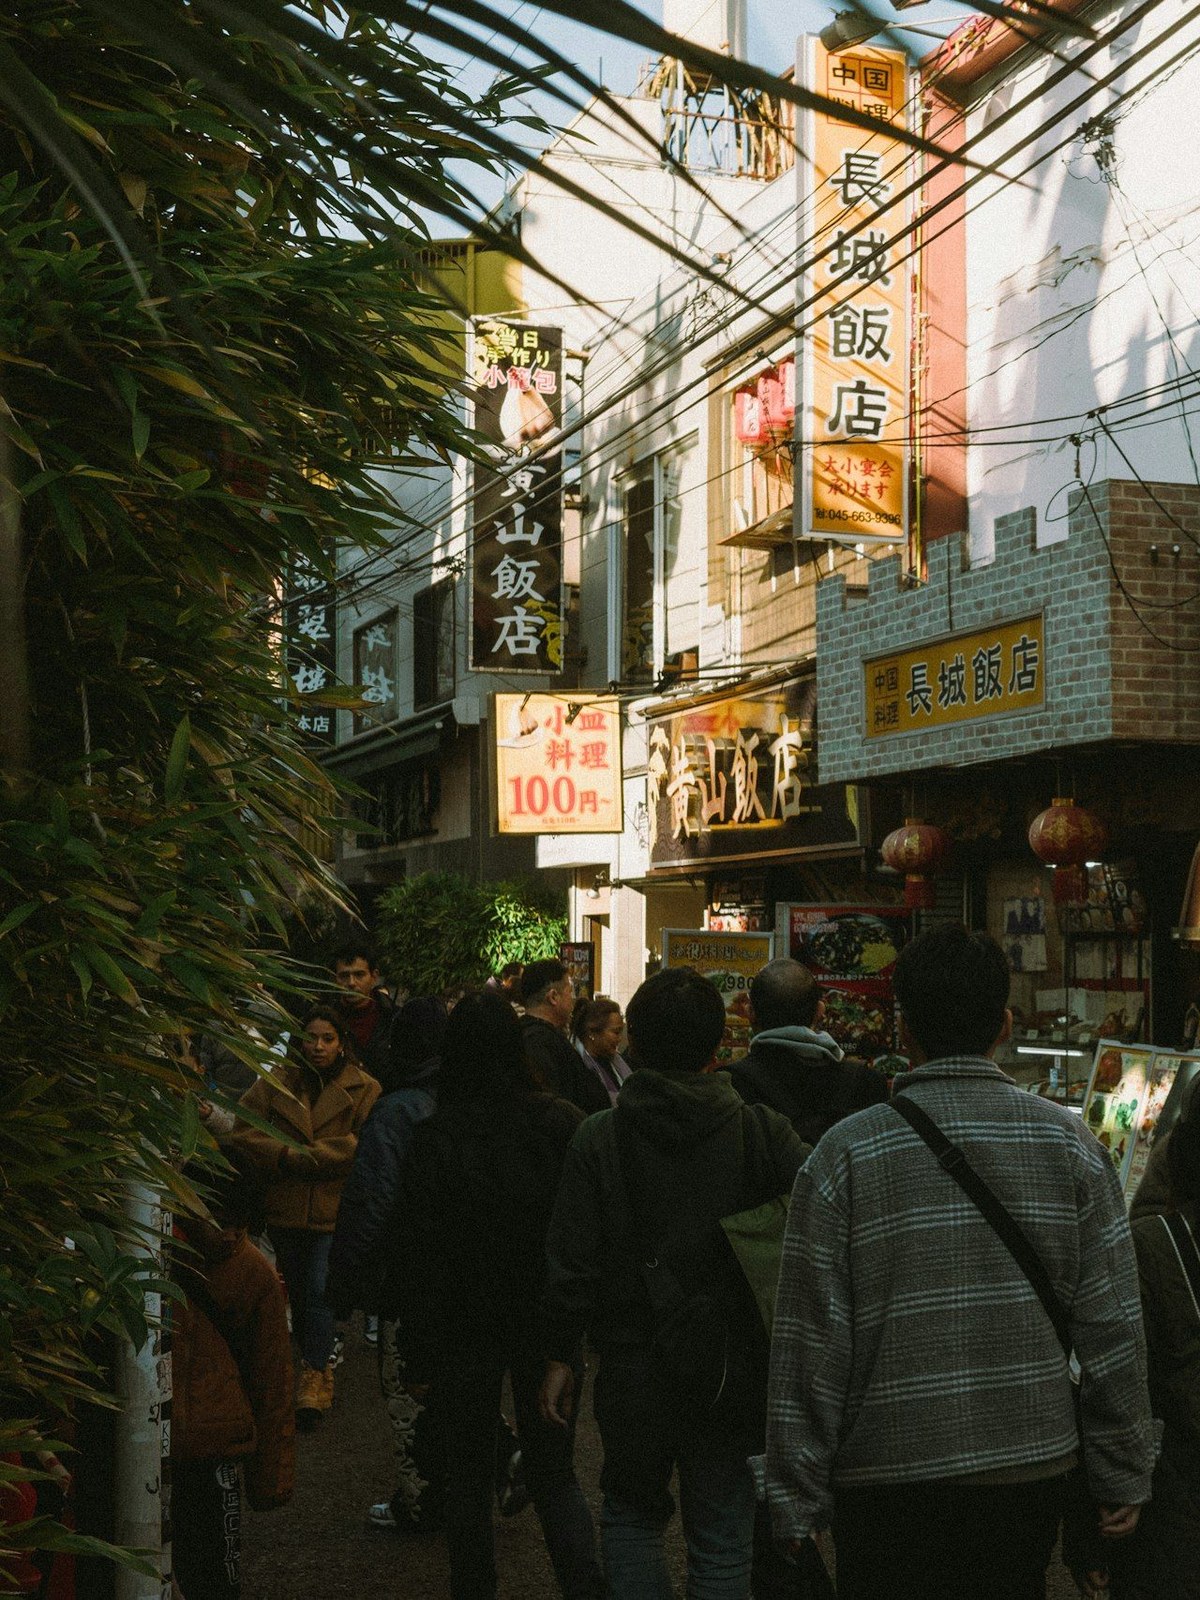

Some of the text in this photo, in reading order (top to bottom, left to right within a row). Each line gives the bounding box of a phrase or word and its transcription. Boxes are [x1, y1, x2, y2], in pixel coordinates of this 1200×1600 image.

[832, 63, 888, 91] 中国
[829, 152, 891, 436] 長城飯店
[499, 328, 539, 349] 当日
[487, 347, 550, 368] 手作り
[823, 455, 894, 478] 大小宴会
[827, 478, 889, 499] 承ります
[490, 446, 546, 656] 黄山飯店
[874, 667, 899, 692] 中国
[906, 635, 1039, 716] 長城飯店
[297, 716, 331, 733] 本店
[544, 705, 606, 736] 小皿
[874, 701, 899, 726] 料理
[545, 738, 608, 771] 料理
[666, 714, 803, 839] 黄山飯店
